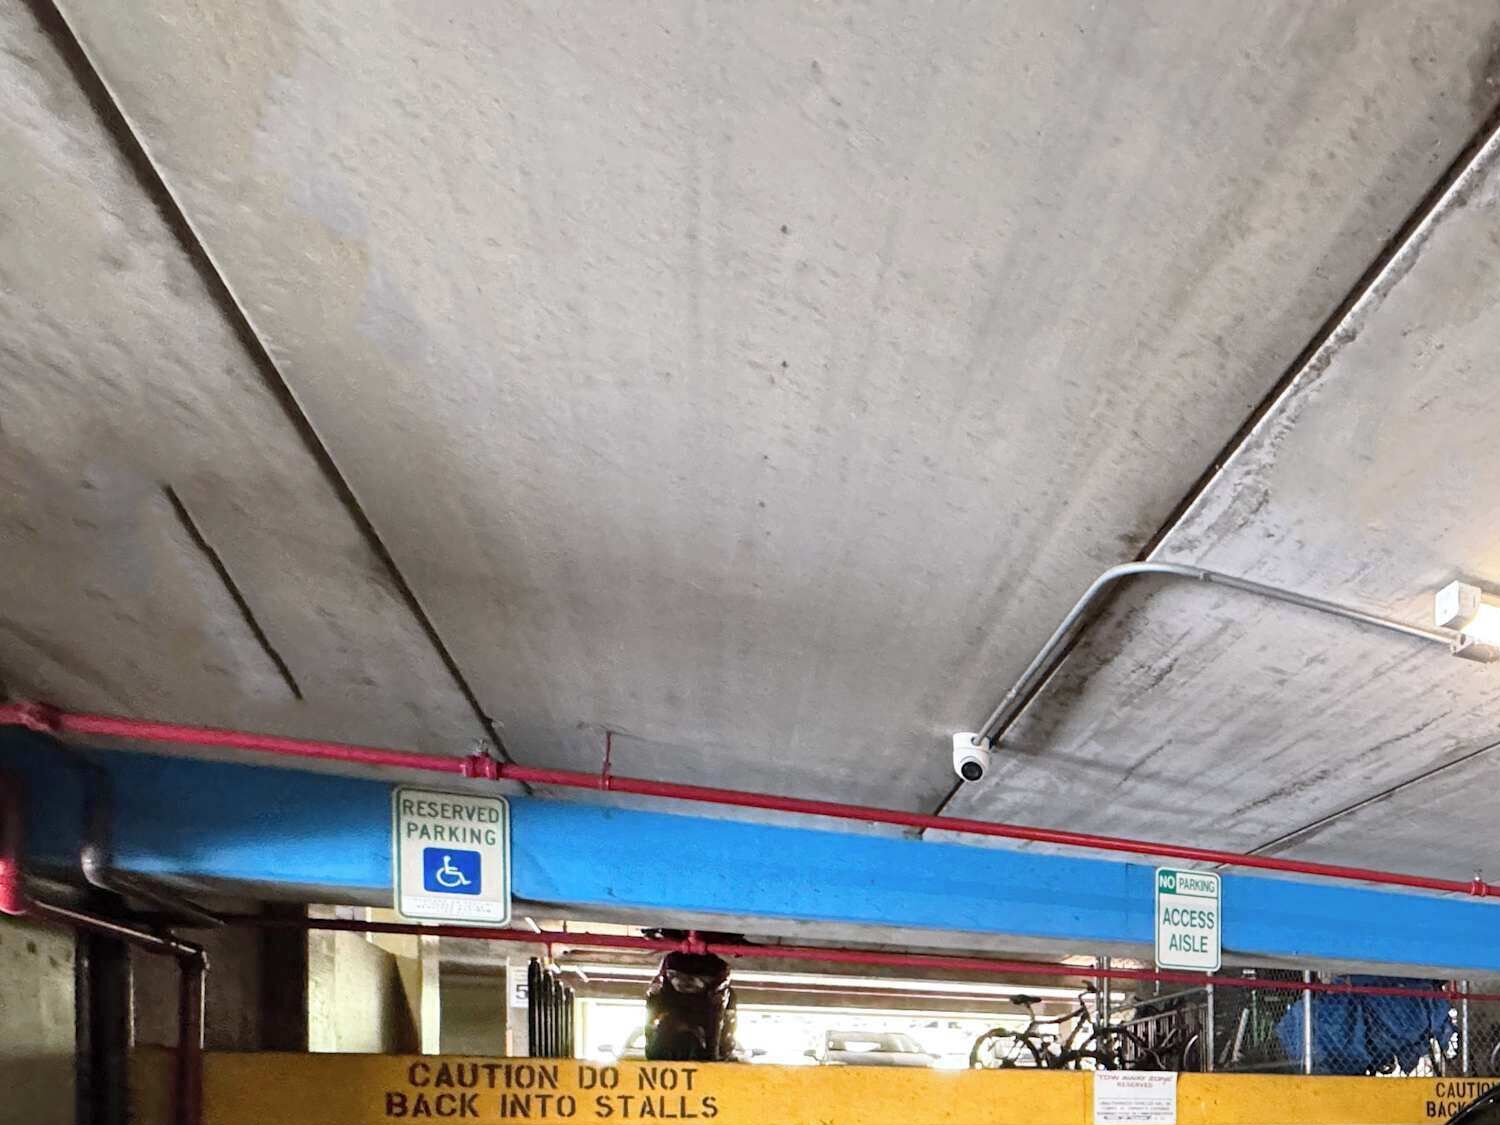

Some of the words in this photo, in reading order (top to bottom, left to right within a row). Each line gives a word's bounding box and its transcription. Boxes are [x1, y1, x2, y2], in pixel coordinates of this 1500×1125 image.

[402, 799, 500, 824] RESERVED
[406, 821, 497, 846] PARKING
[1160, 875, 1176, 889] NO
[1179, 877, 1215, 893] PARKING
[1163, 907, 1215, 930] ACCESS
[1169, 933, 1209, 953] AISLE
[408, 1063, 559, 1089] CAUTION
[578, 1065, 619, 1090] DO
[638, 1067, 697, 1091] NOT
[1435, 1081, 1497, 1099] CAUTIO
[384, 1091, 480, 1118] BACK
[500, 1094, 577, 1118] INTO
[595, 1095, 719, 1119] STALLS
